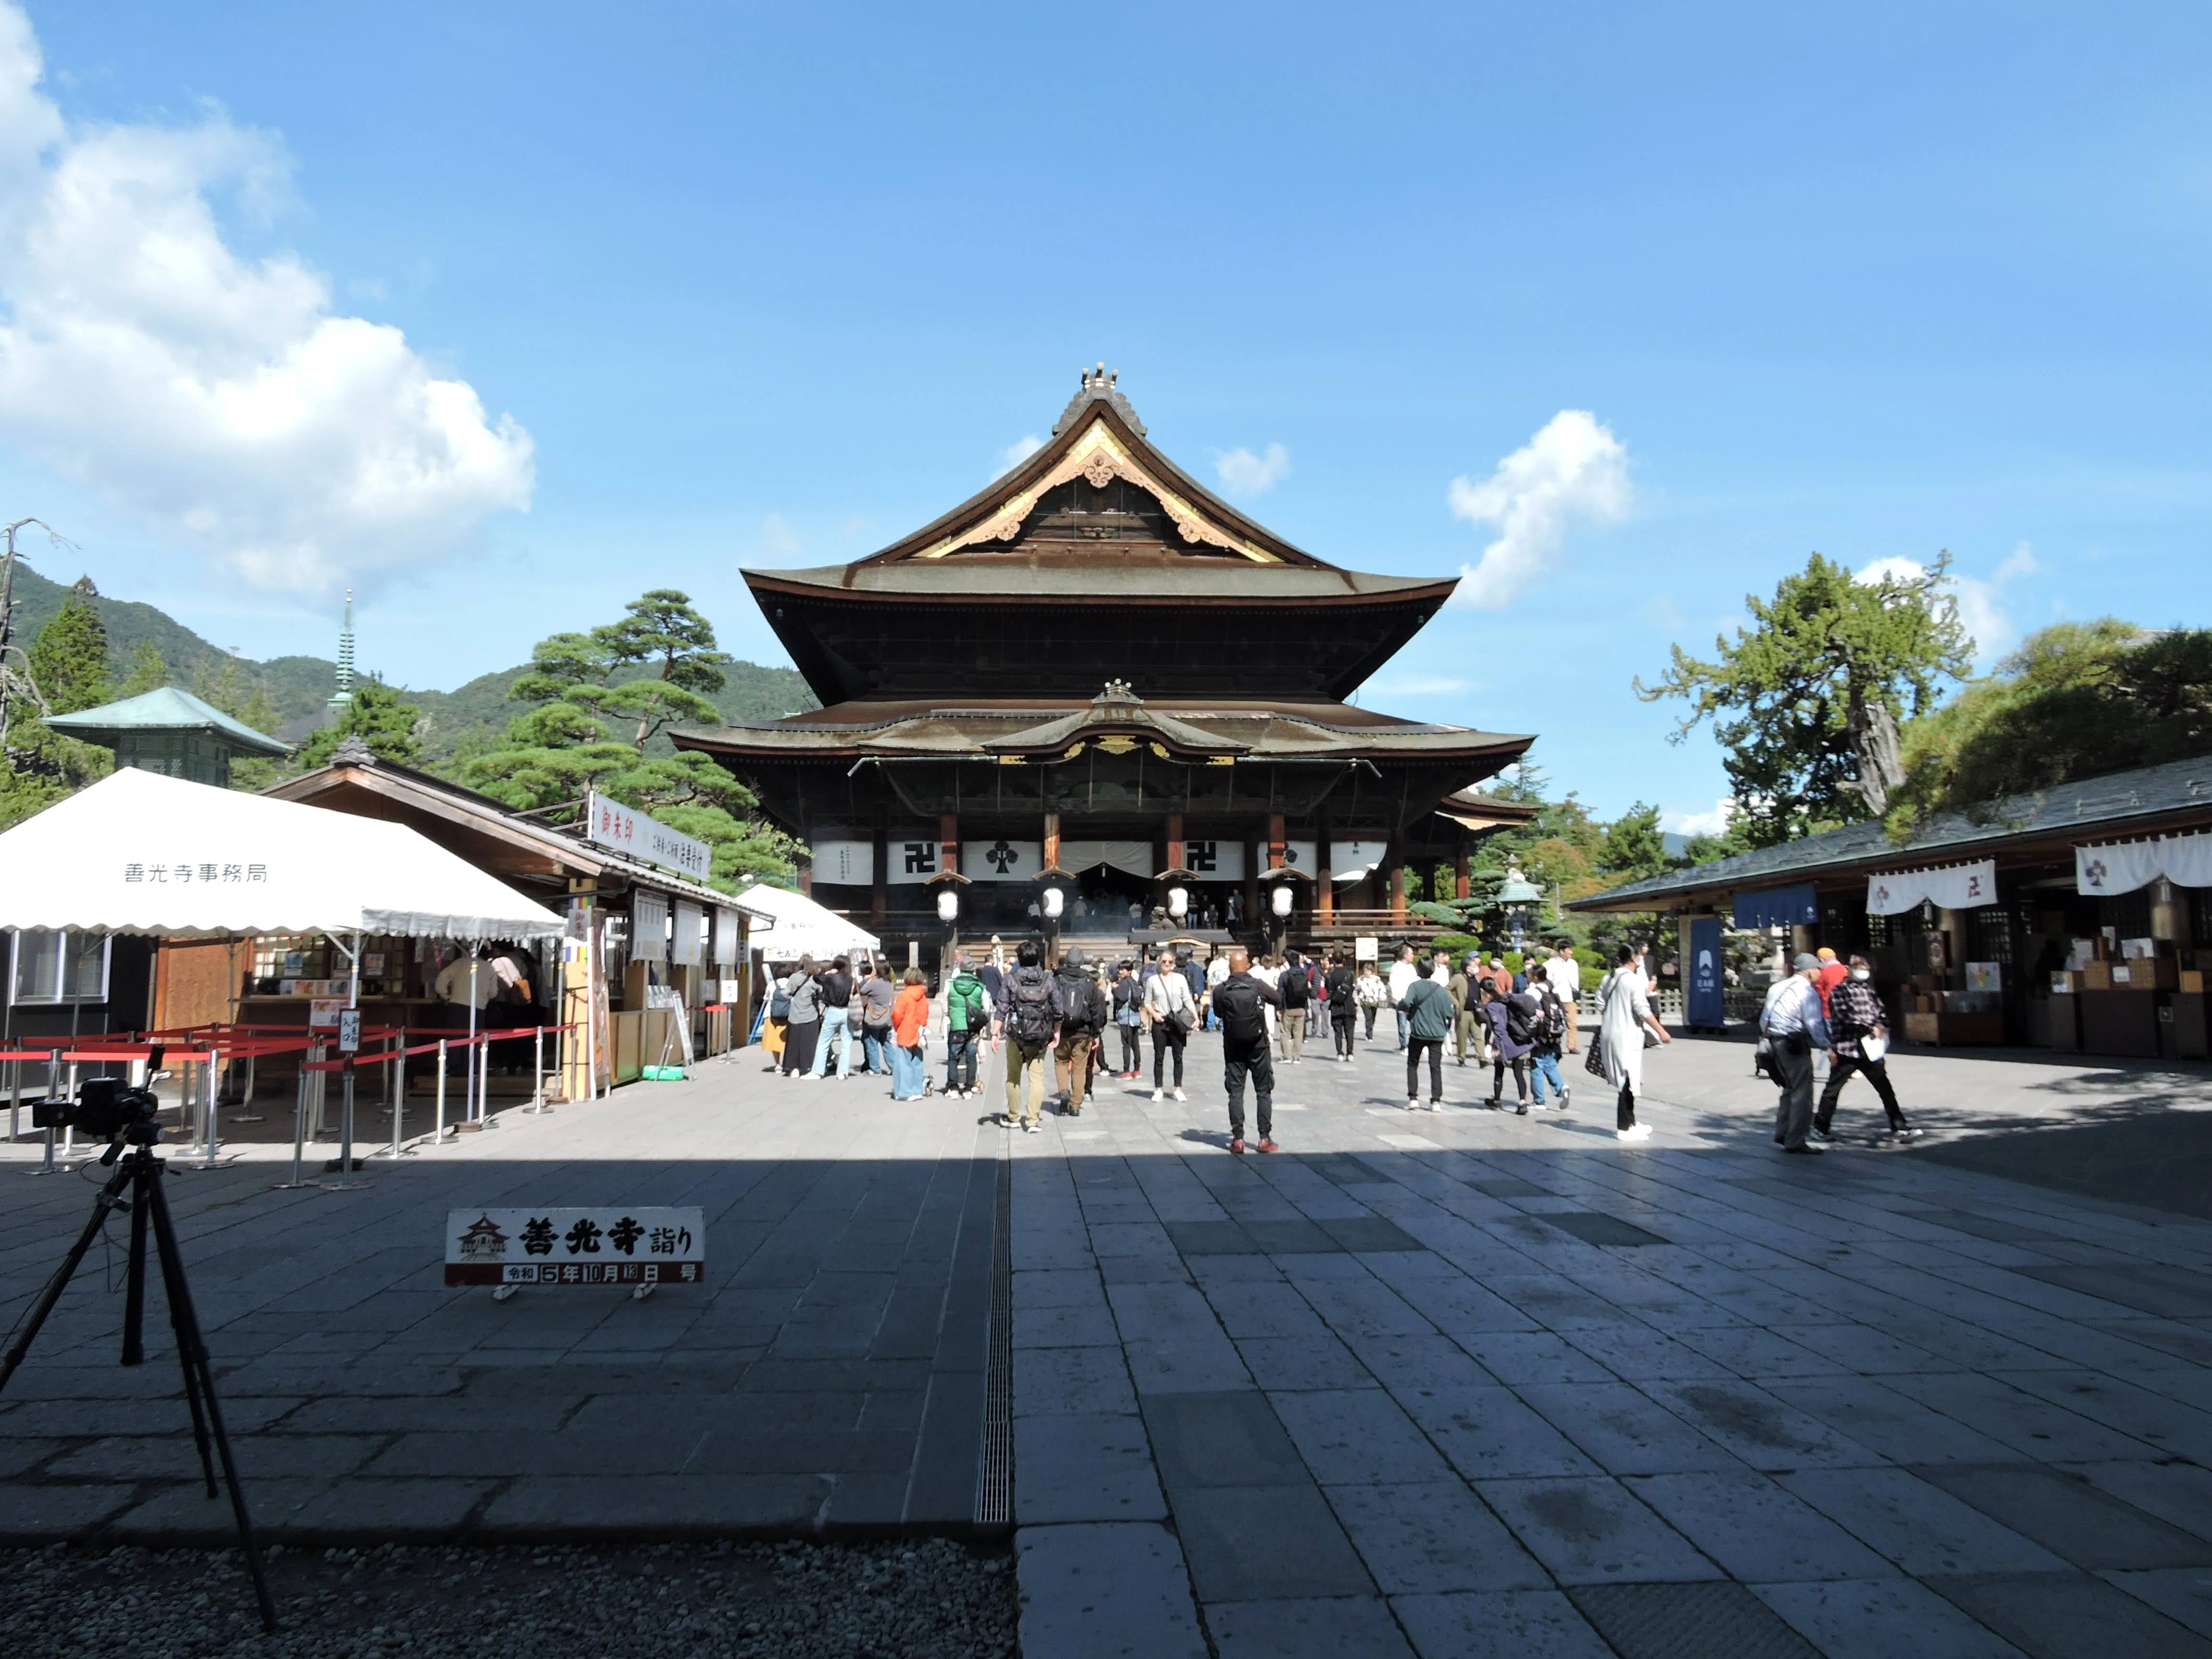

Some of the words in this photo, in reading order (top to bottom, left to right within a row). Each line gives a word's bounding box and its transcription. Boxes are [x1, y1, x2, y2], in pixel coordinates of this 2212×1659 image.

[601, 805, 633, 845] 御朱印
[124, 863, 267, 883] 善光寺事務局
[518, 1216, 692, 1256] 善光寺詣り
